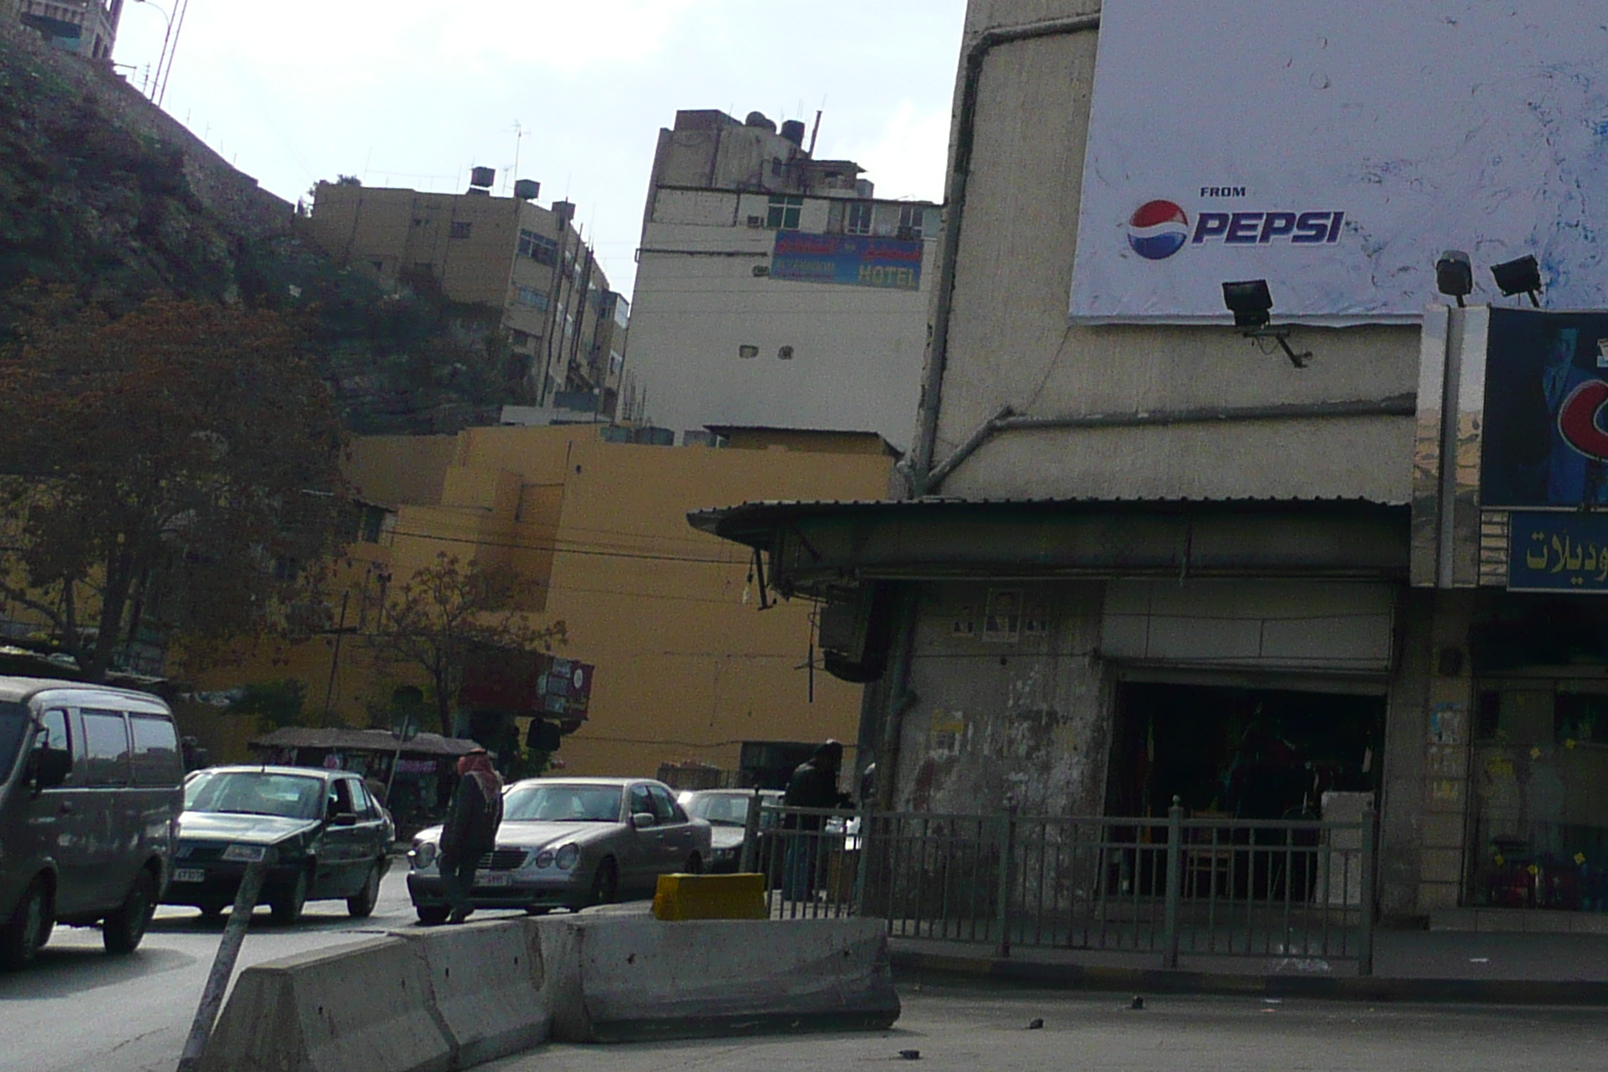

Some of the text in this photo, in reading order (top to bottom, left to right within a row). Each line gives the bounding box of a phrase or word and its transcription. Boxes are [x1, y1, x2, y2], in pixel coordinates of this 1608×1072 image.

[1200, 186, 1246, 198] FROM
[1191, 211, 1346, 245] PEPSI
[859, 265, 915, 287] HOTEL
